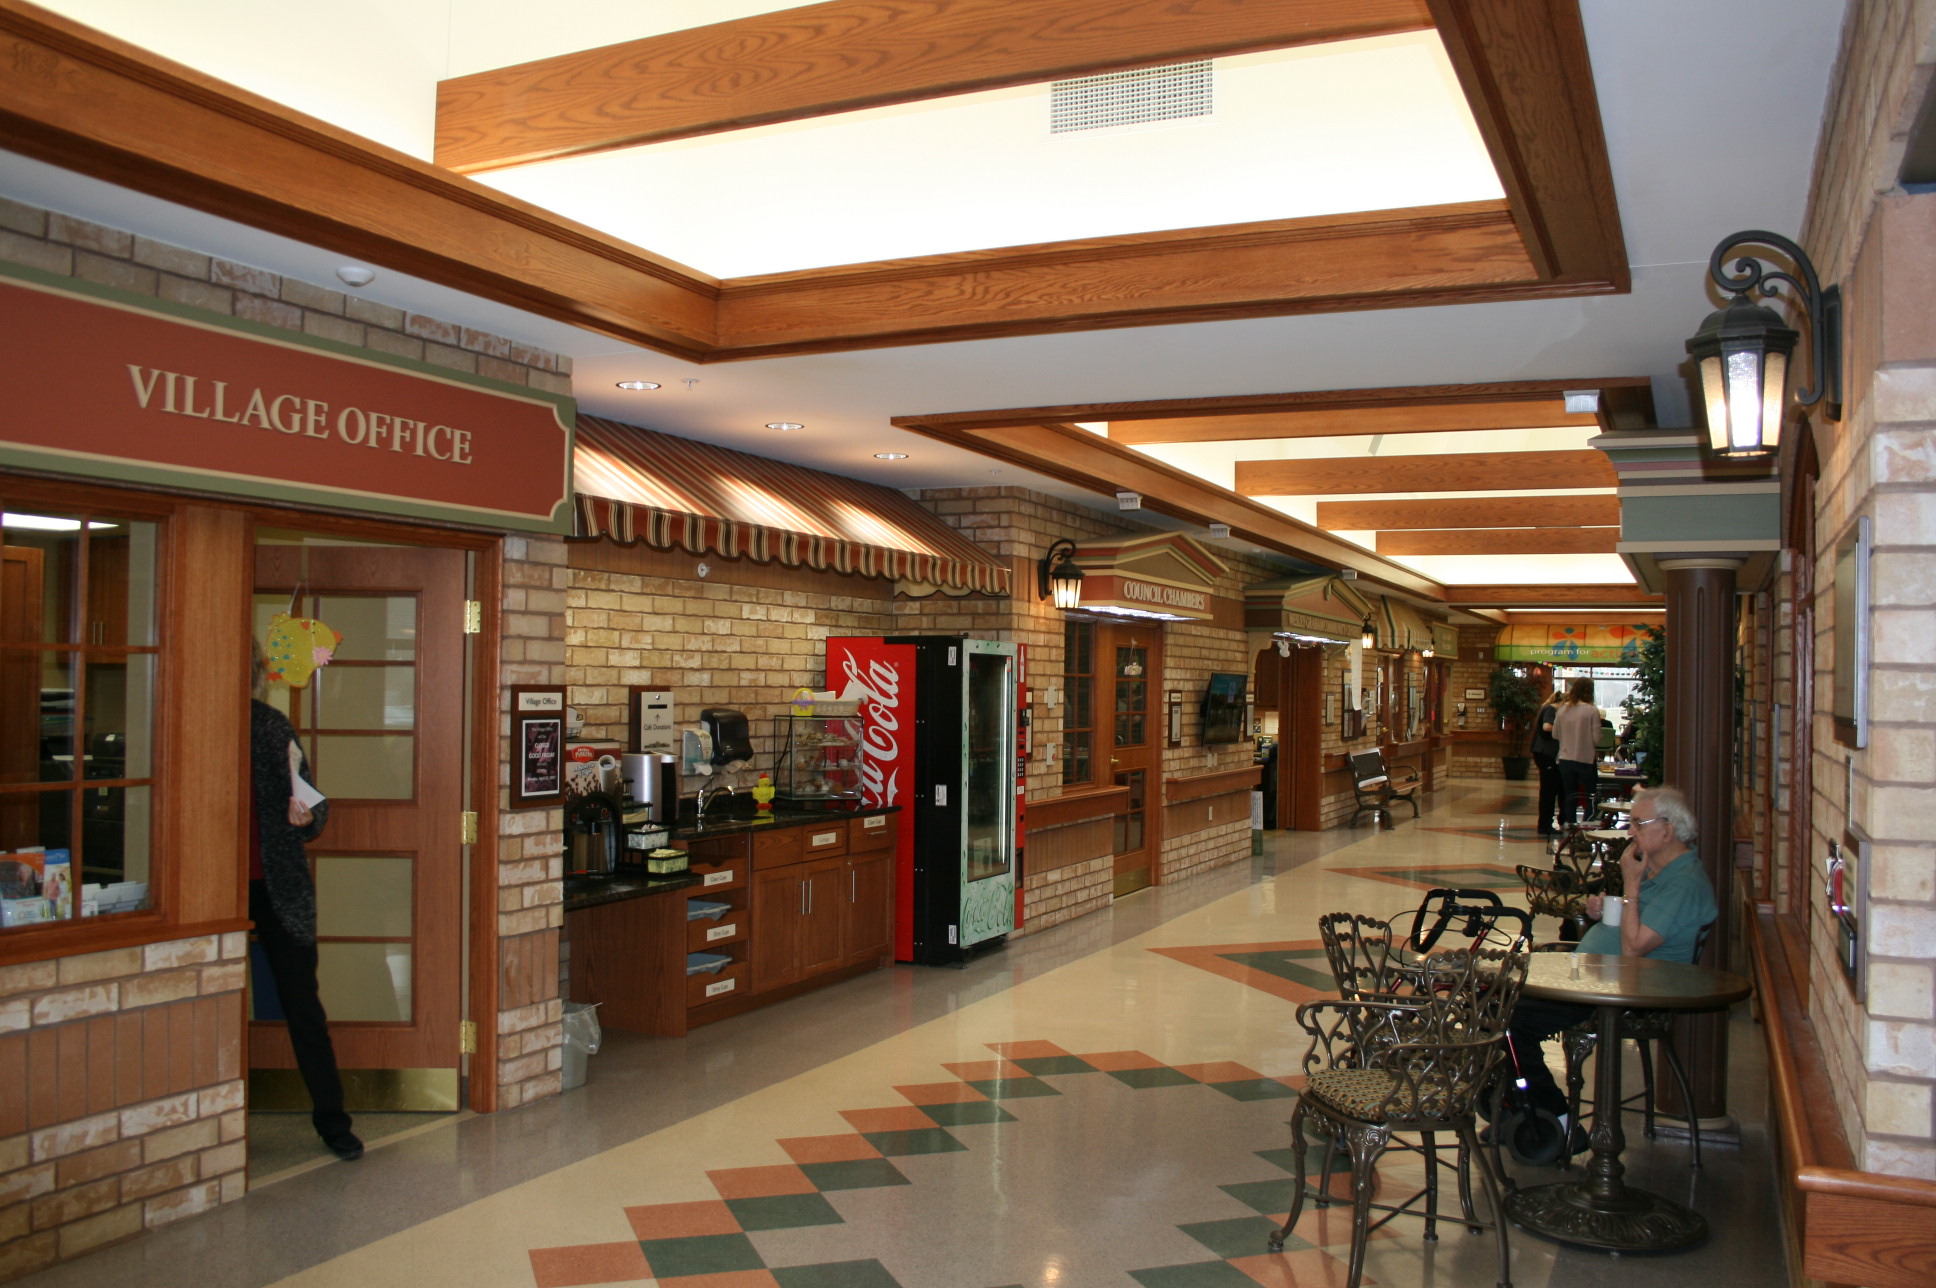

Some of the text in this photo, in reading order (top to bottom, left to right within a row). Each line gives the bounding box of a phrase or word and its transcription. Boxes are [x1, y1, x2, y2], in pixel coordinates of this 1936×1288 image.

[126, 363, 473, 464] VILLAGE OFFICE
[1123, 580, 1205, 610] COUNCIL CHAMBERS
[1530, 648, 1574, 656] program
[1576, 647, 1590, 655] for
[525, 697, 557, 707] Village Office
